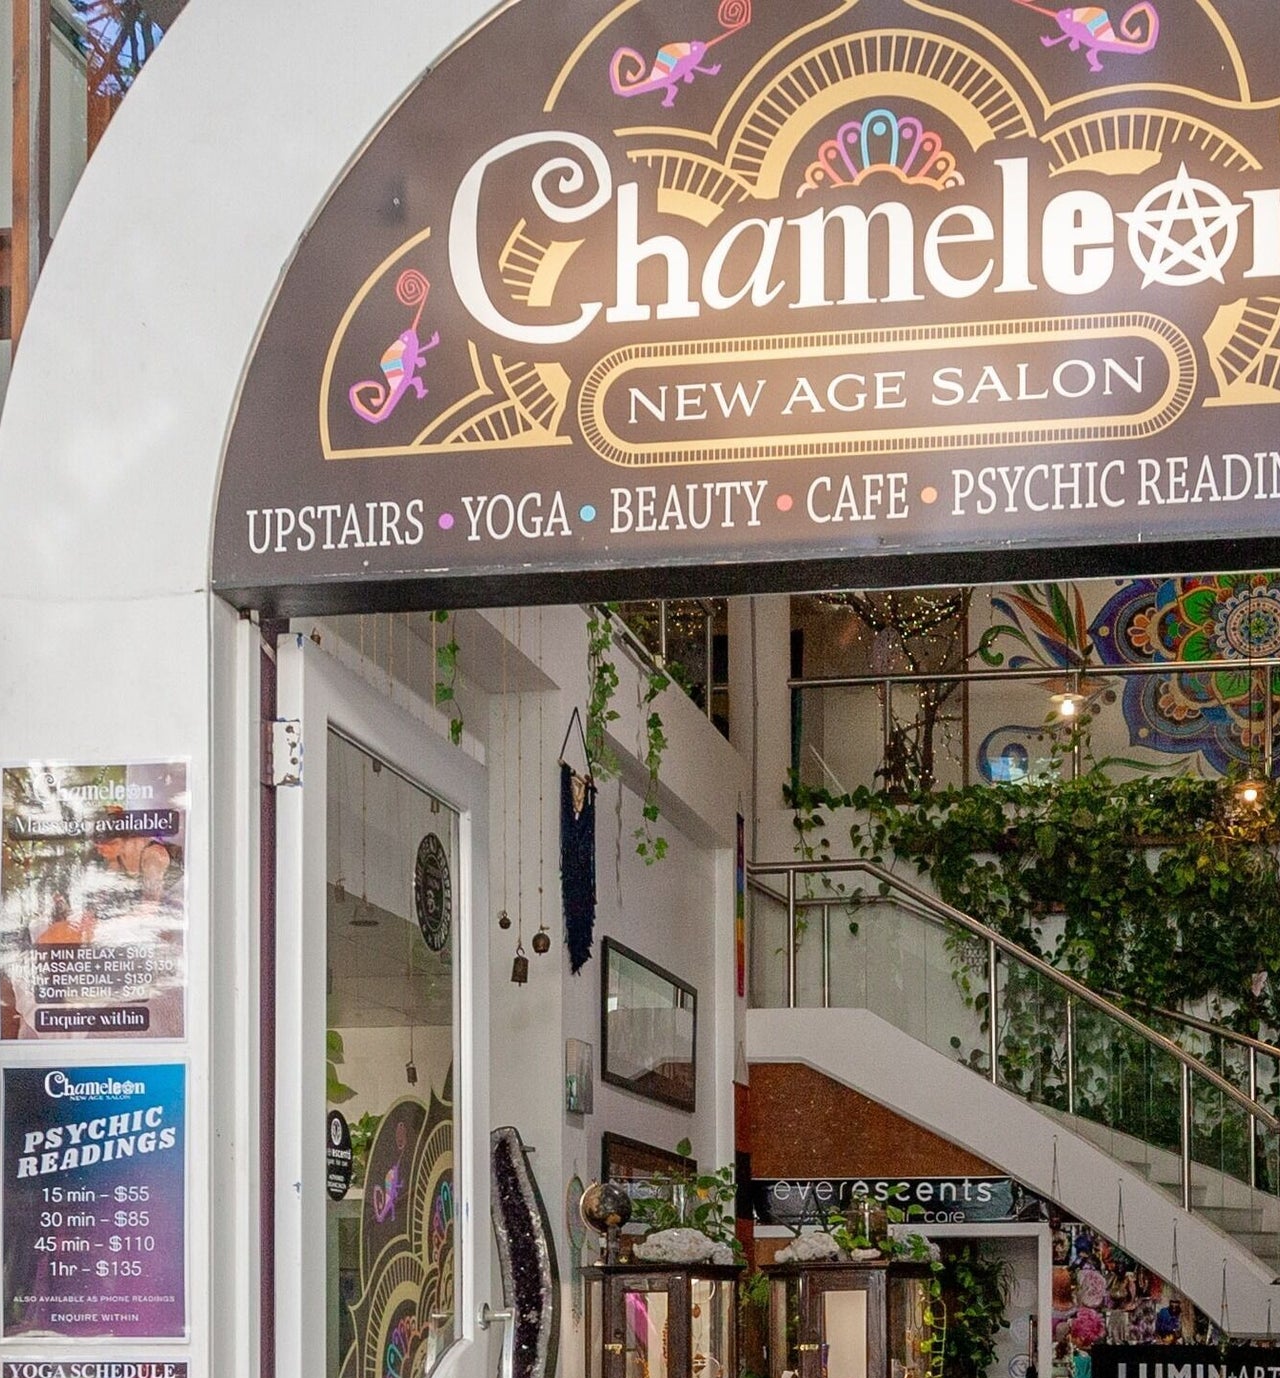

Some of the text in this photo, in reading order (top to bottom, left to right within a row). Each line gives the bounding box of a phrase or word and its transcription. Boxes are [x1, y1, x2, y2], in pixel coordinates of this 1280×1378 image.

[628, 356, 1144, 423] NEW AGE SALON
[246, 499, 424, 554] UPSTAIRS
[461, 490, 572, 539] YOGA
[610, 480, 768, 533] BEAUTY
[806, 474, 909, 523] CAFE
[951, 459, 1125, 516] PSYCHIC
[95, 812, 173, 832] available!
[50, 948, 115, 960] MIN RELAX
[31, 961, 92, 973] MASSAGE
[104, 961, 135, 972] REIKI
[52, 972, 152, 985] REMEDIAL $130
[38, 986, 79, 998] 30min
[82, 986, 112, 998] REIKI
[40, 1008, 144, 1030] Enquire within
[44, 1070, 145, 1099] Chameleon
[24, 1105, 163, 1154] PSYCHIC
[17, 1127, 176, 1179] READINGS
[41, 1185, 150, 1203] 15 min $55
[40, 1210, 150, 1228] 30 min $85
[924, 1209, 965, 1223] care
[34, 1235, 155, 1252] 45 min $110
[49, 1259, 142, 1277] 1hr $135
[51, 1313, 139, 1322] ENQUIRE WITHIN
[70, 1364, 176, 1378] SCHEDULE
